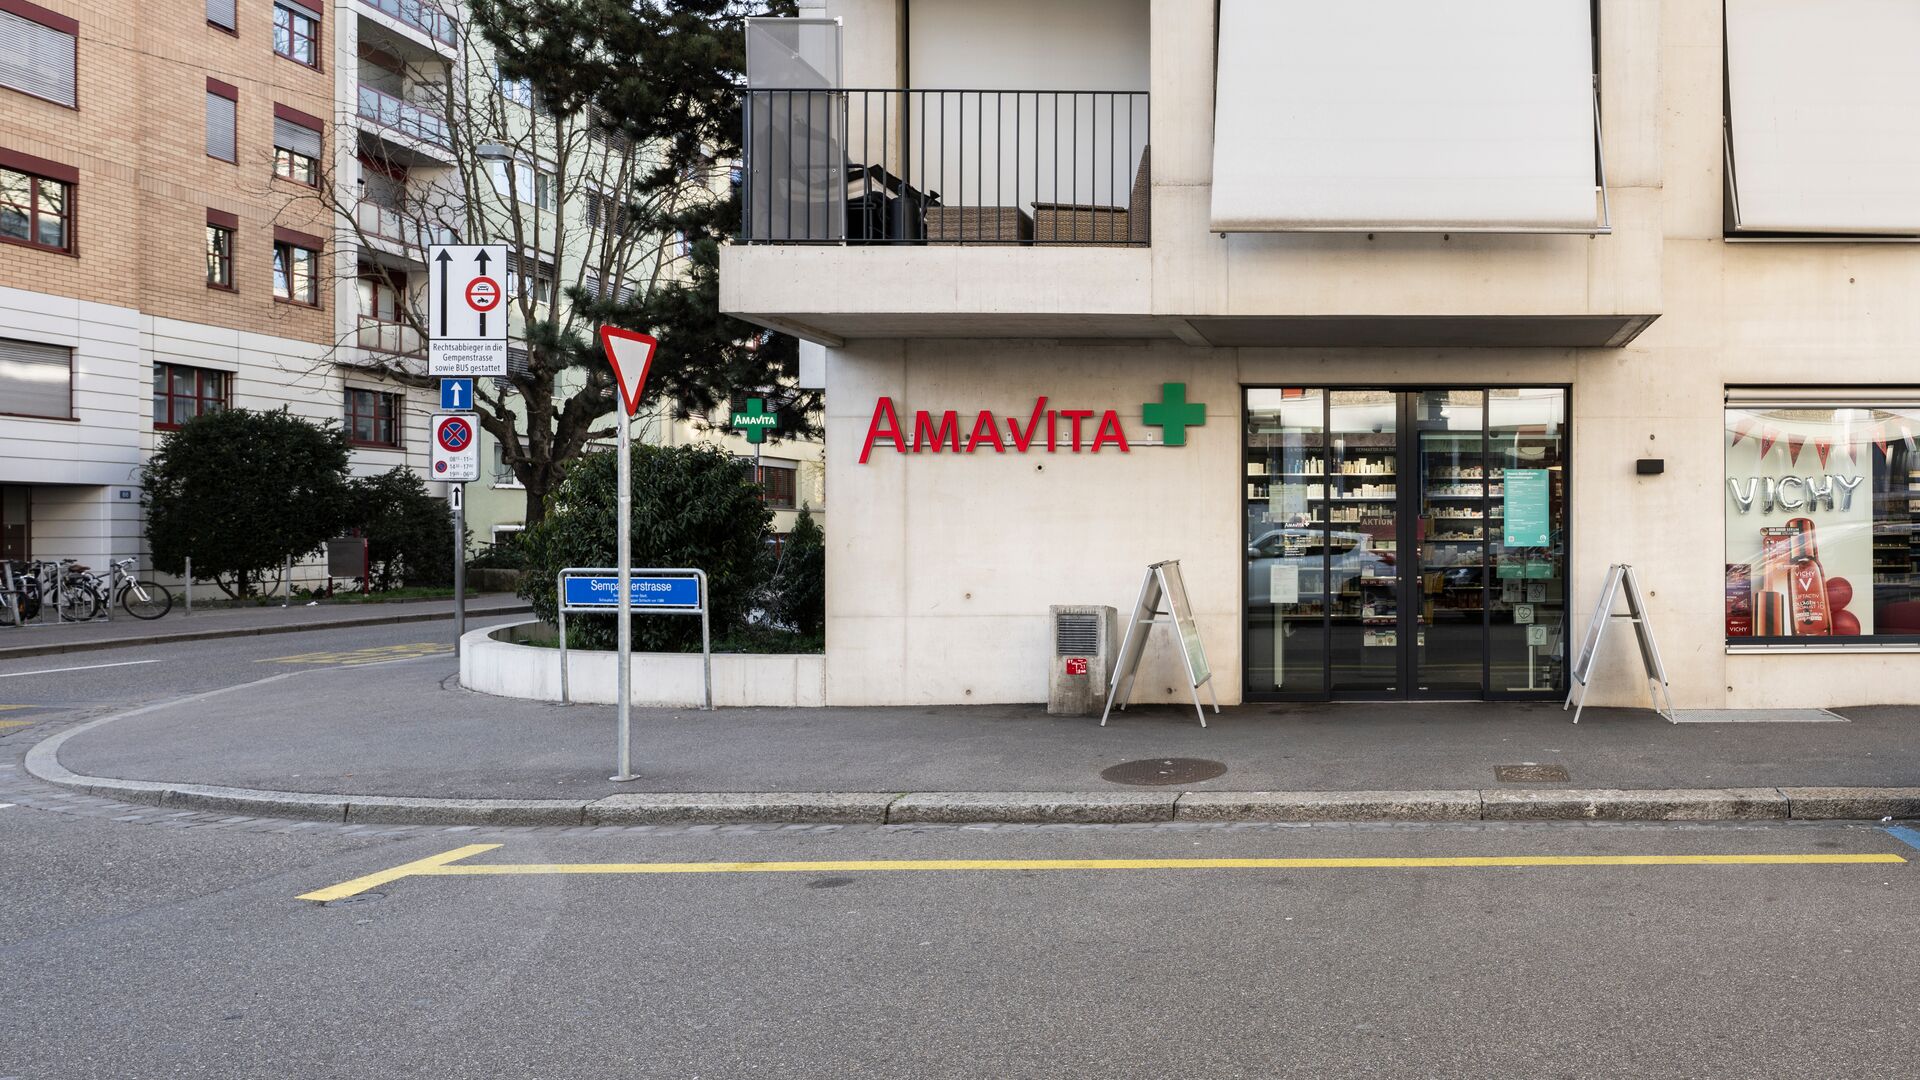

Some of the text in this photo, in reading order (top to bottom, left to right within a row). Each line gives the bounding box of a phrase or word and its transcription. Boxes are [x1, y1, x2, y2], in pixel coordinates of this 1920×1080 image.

[433, 343, 503, 353] Rechtsabbieger in die
[443, 353, 493, 363] Gempenstrasse
[435, 364, 500, 374] sowie BUS gestattet
[734, 414, 775, 426] AMAVITA
[858, 396, 1130, 464] AMAVITA
[1728, 474, 1864, 514] VICHY
[1361, 518, 1393, 526] AKTION
[590, 579, 673, 594] Sempaerstrasse
